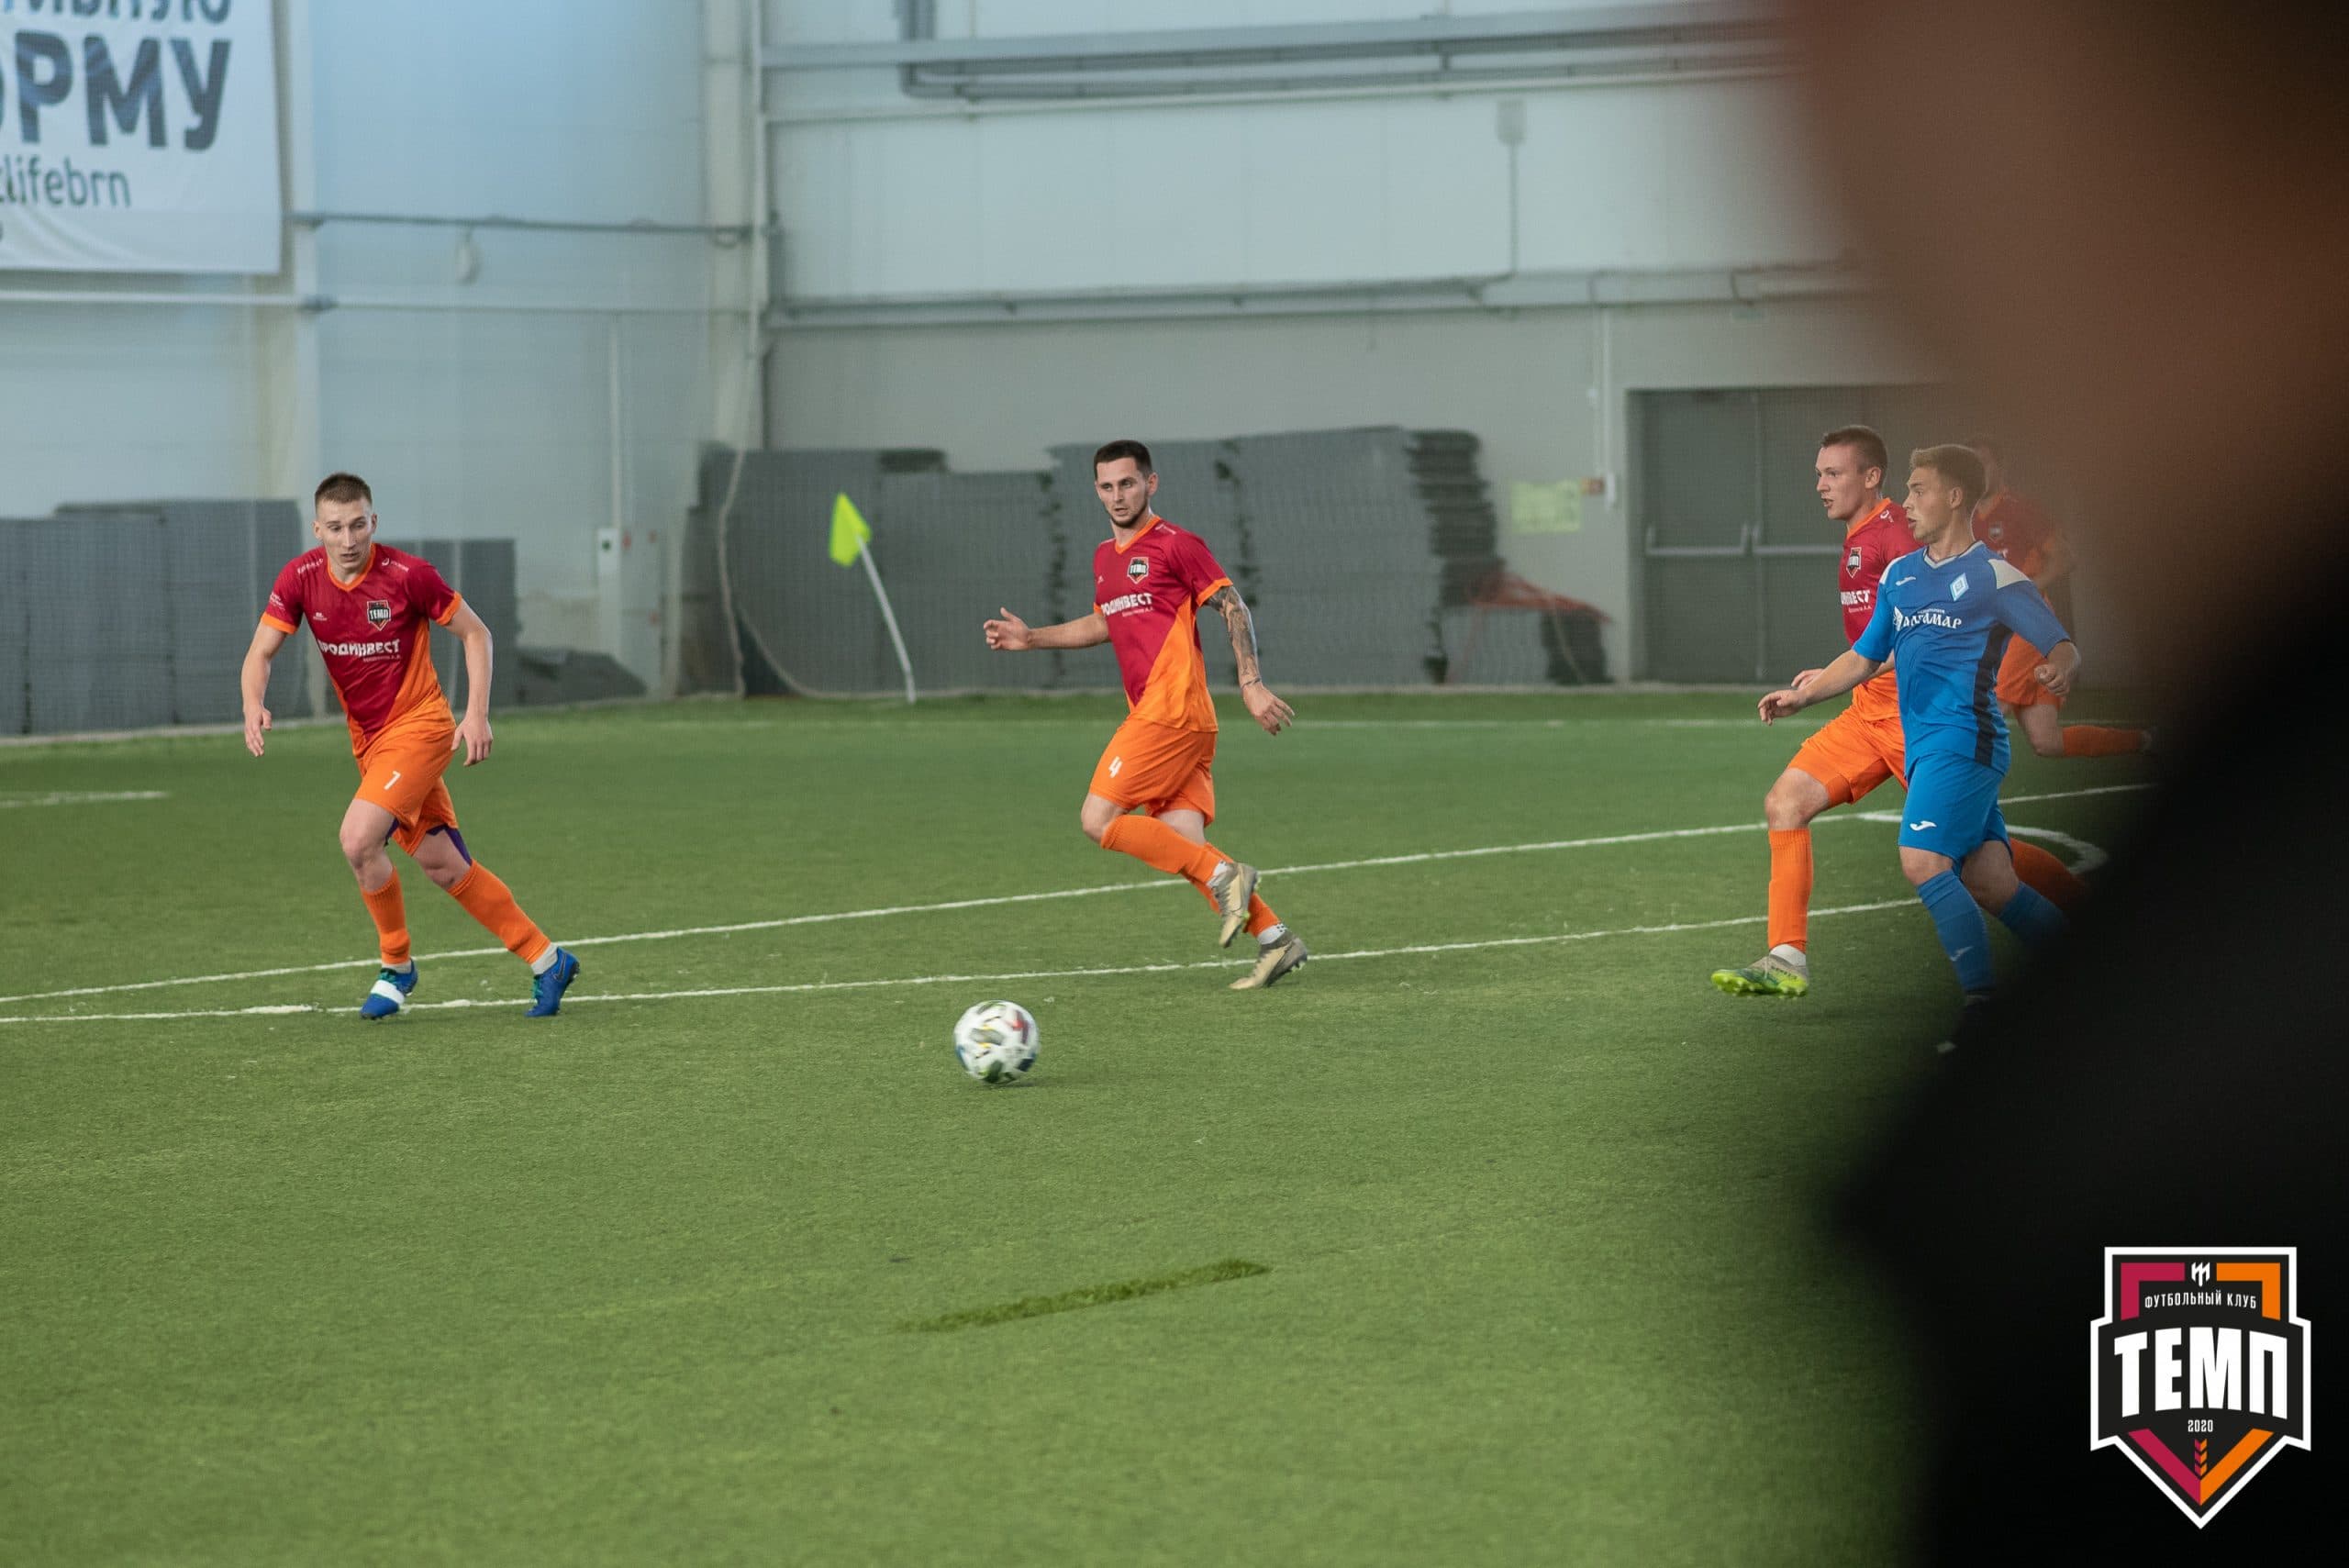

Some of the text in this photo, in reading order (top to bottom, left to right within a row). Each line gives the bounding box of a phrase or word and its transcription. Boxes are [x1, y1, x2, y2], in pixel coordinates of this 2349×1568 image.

[0, 29, 232, 151] РМУ
[0, 154, 131, 207] lifebrn
[384, 770, 401, 790] 7
[1108, 755, 1123, 779] 4
